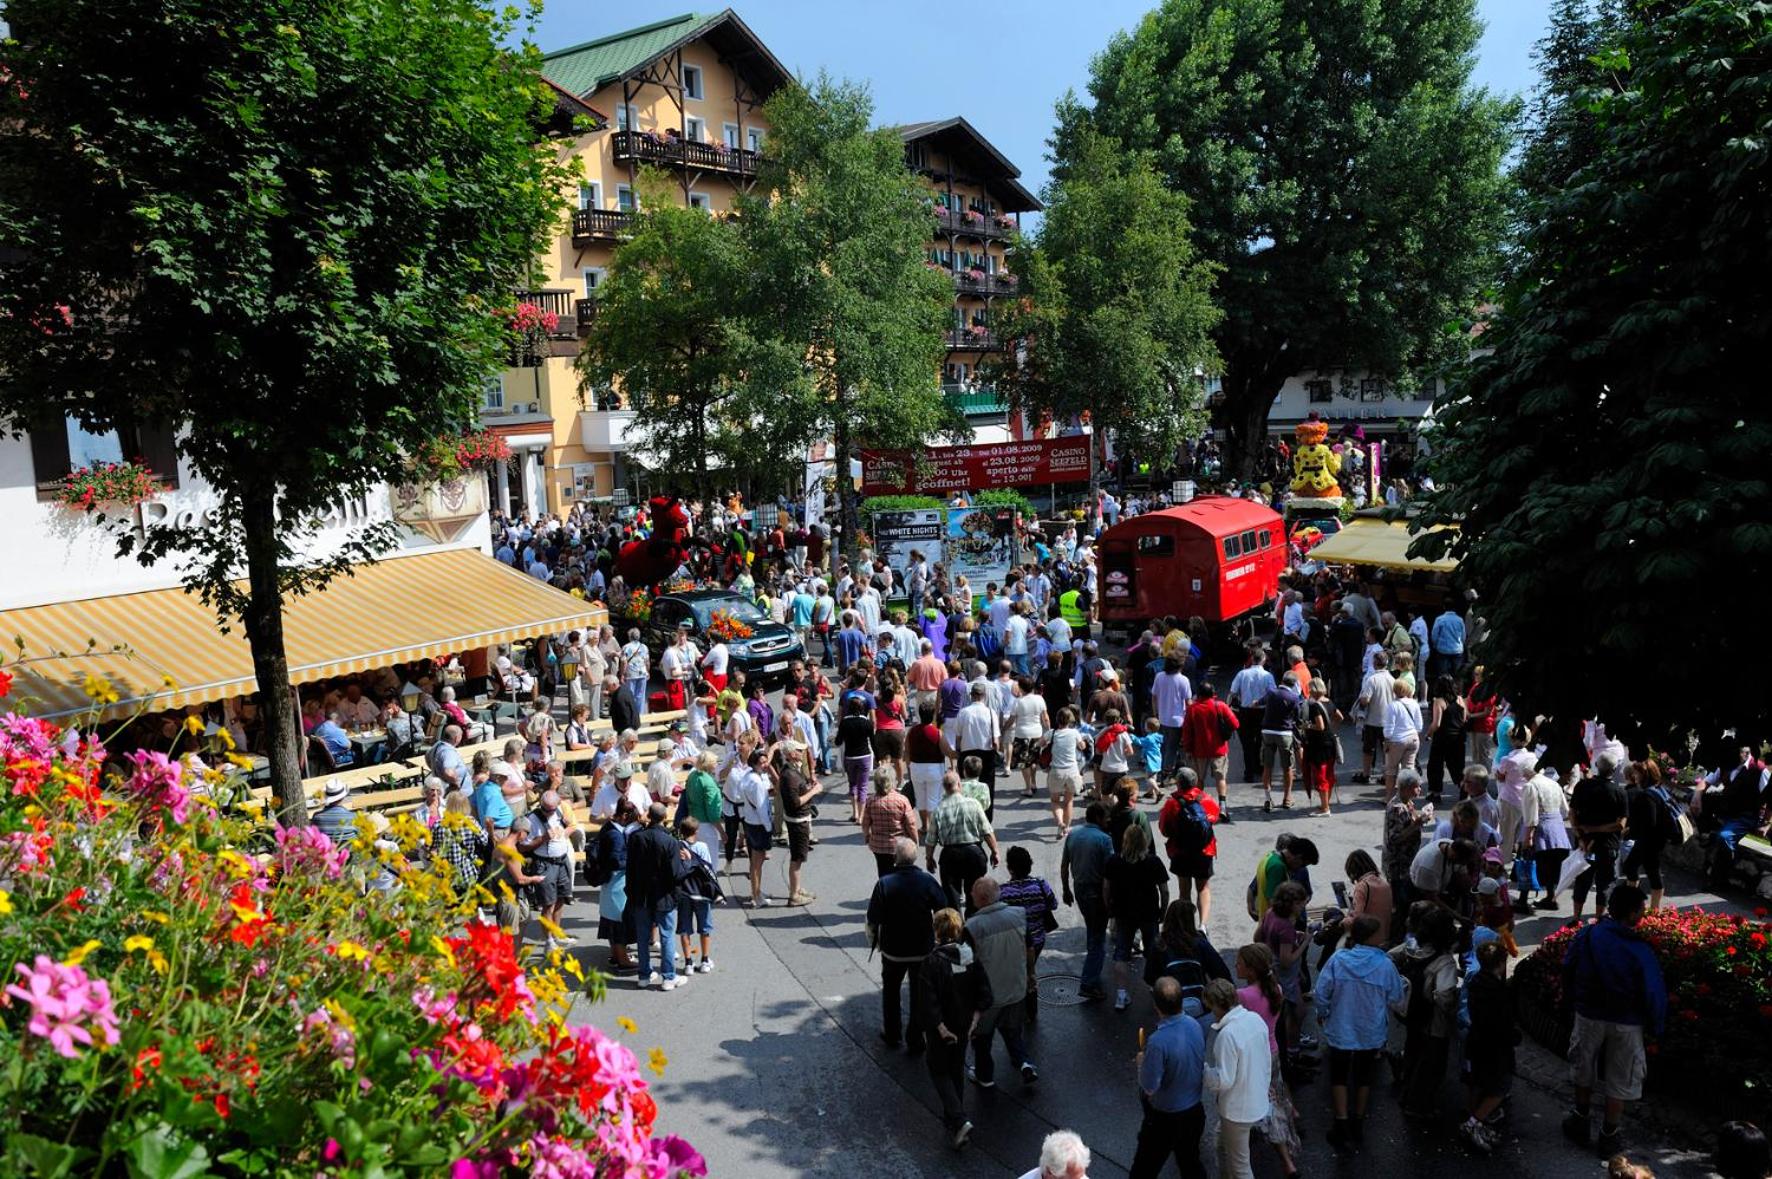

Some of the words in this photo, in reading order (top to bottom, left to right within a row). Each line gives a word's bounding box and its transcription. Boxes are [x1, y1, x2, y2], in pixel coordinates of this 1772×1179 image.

[1307, 407, 1387, 419] AILER
[956, 448, 973, 458] 23.
[991, 445, 1042, 455] 01.08.2009
[1051, 447, 1086, 457] CASINO
[990, 455, 1041, 466] 23.08.2009
[987, 465, 1018, 477] aperto
[888, 526, 912, 536] WHITE
[912, 526, 938, 535] NIGHTS
